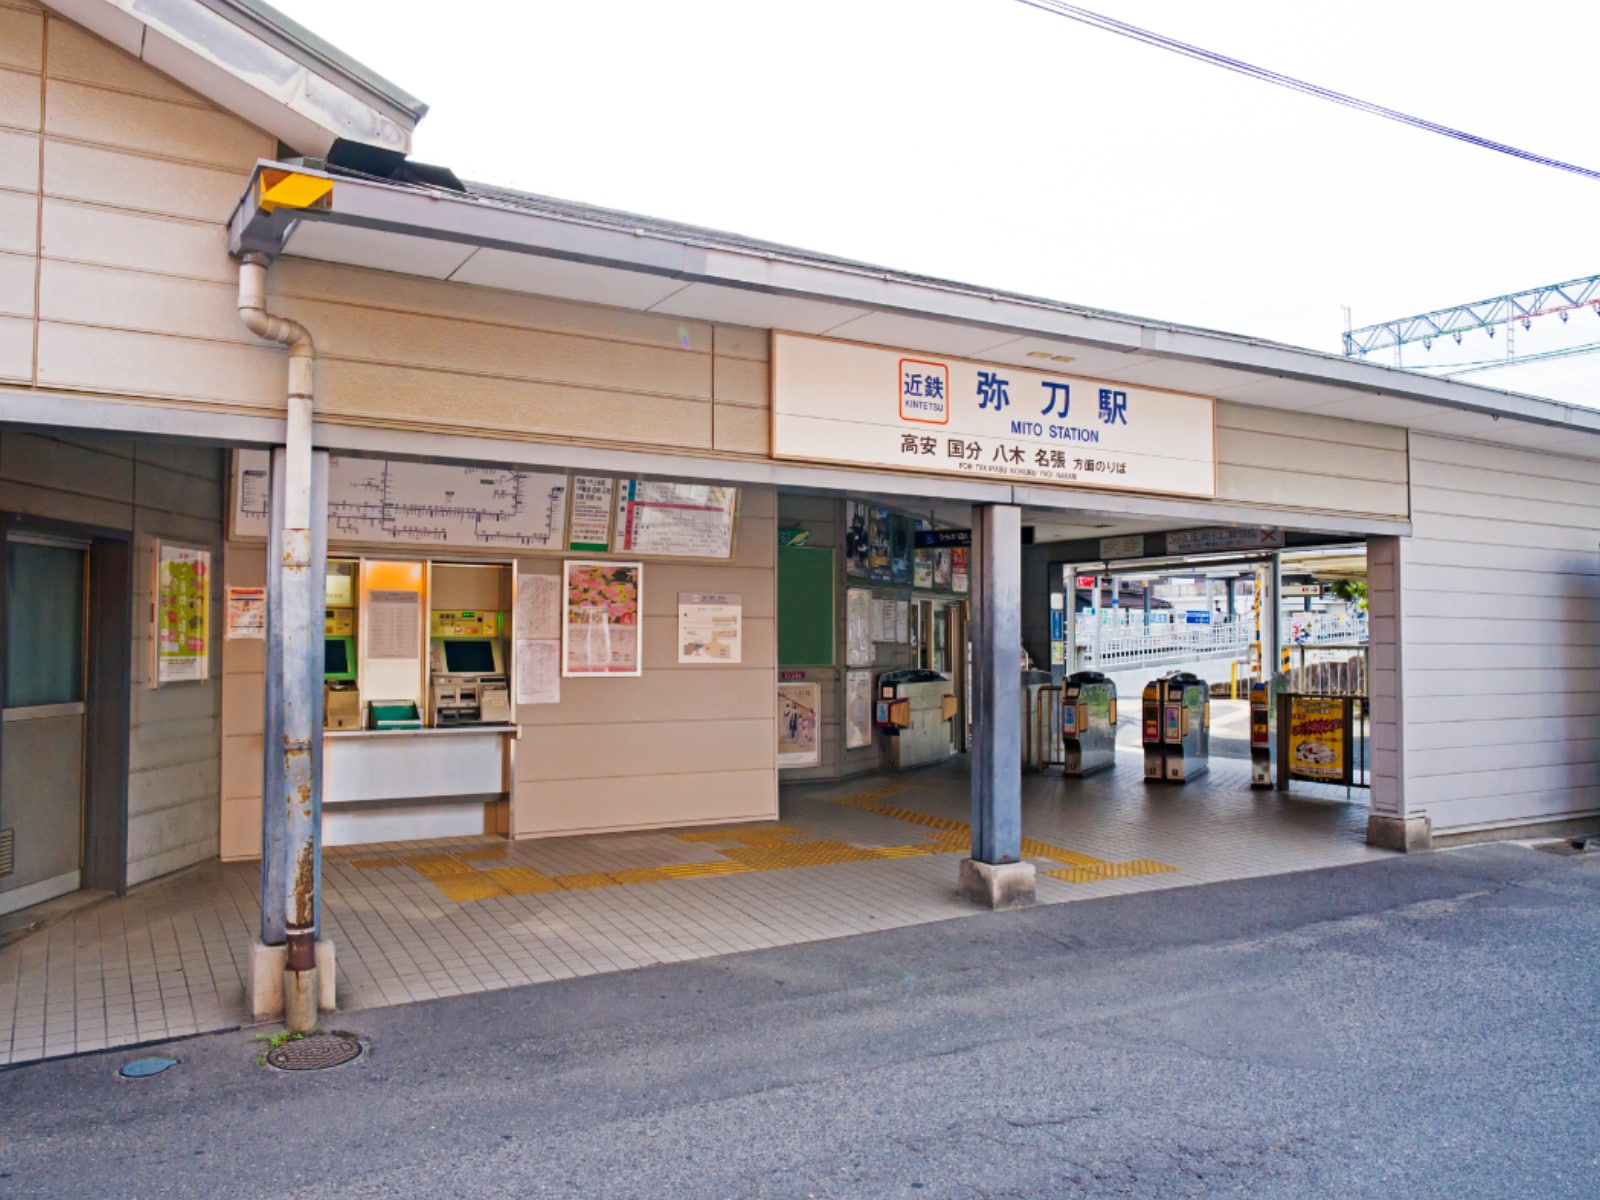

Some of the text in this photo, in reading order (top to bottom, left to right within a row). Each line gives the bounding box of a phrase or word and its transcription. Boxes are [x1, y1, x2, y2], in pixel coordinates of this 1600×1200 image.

[904, 372, 944, 399] 近鉄
[976, 370, 1128, 425] 弥刀駅
[905, 399, 944, 412] KINTETSU
[1010, 420, 1099, 442] MITO STATION
[901, 433, 1127, 474] 高安 国分 八木 名張 方面のりば
